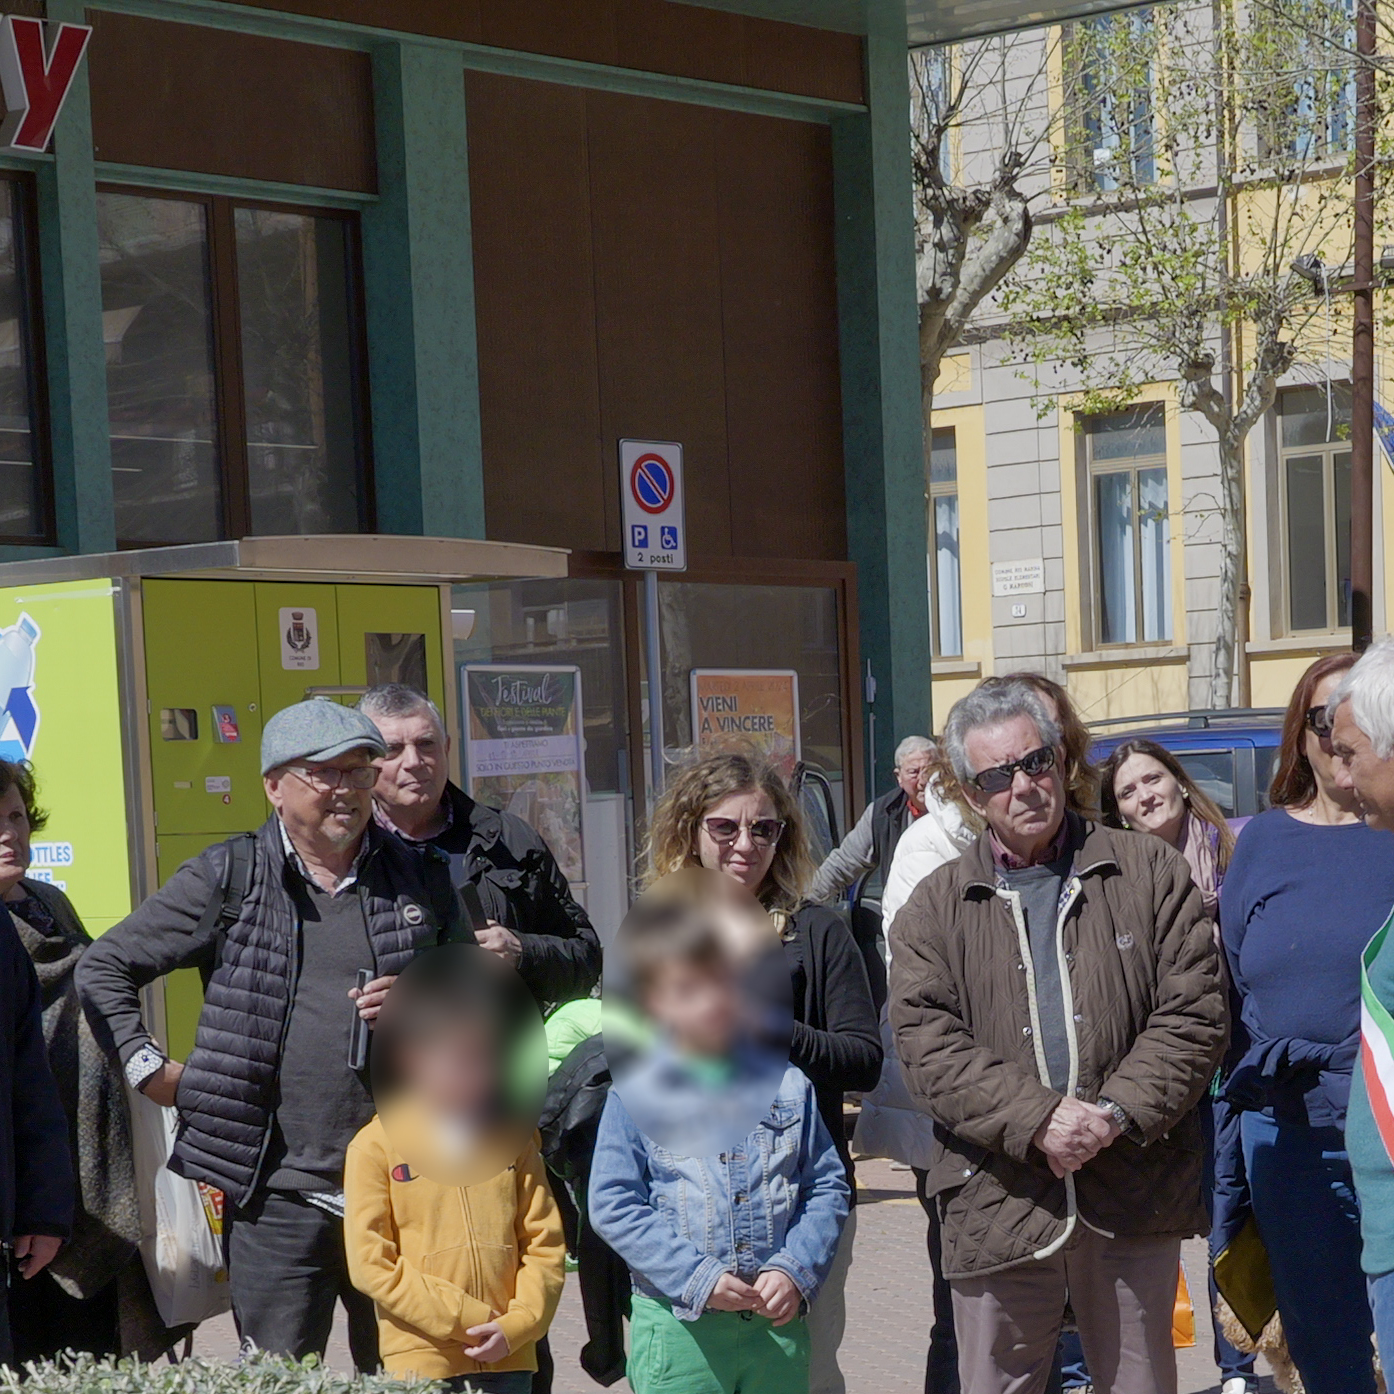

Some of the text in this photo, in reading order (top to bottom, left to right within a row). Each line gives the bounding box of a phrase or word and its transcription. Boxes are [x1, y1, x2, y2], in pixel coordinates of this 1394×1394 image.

[634, 526, 646, 546] P
[637, 552, 674, 565] 2 posti
[491, 673, 552, 706] Festival
[699, 696, 738, 712] VIENI
[701, 715, 774, 733] A VINCERE
